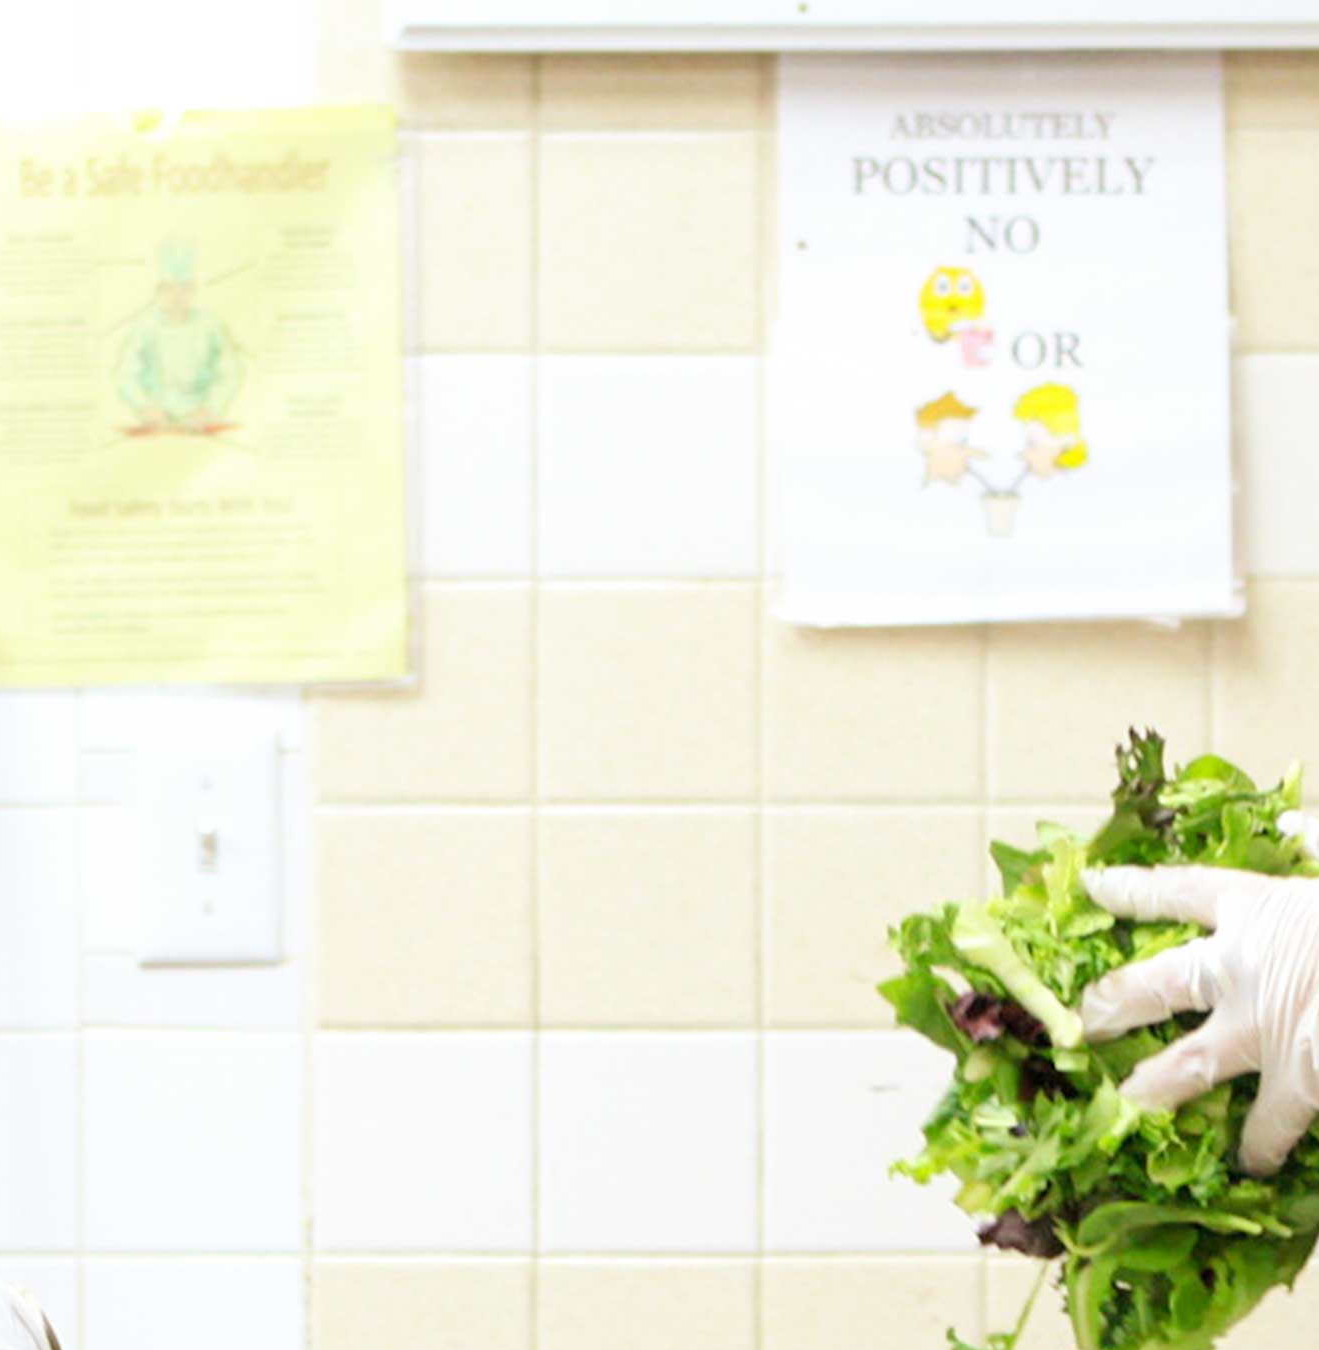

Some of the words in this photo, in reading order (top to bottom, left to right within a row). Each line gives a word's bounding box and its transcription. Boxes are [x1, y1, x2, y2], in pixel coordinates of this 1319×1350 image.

[888, 111, 1117, 140] ABSOLUTELY
[19, 156, 54, 197] Be
[851, 154, 1156, 196] POSITIVELY
[964, 214, 1042, 256] NO
[1010, 330, 1085, 371] OR
